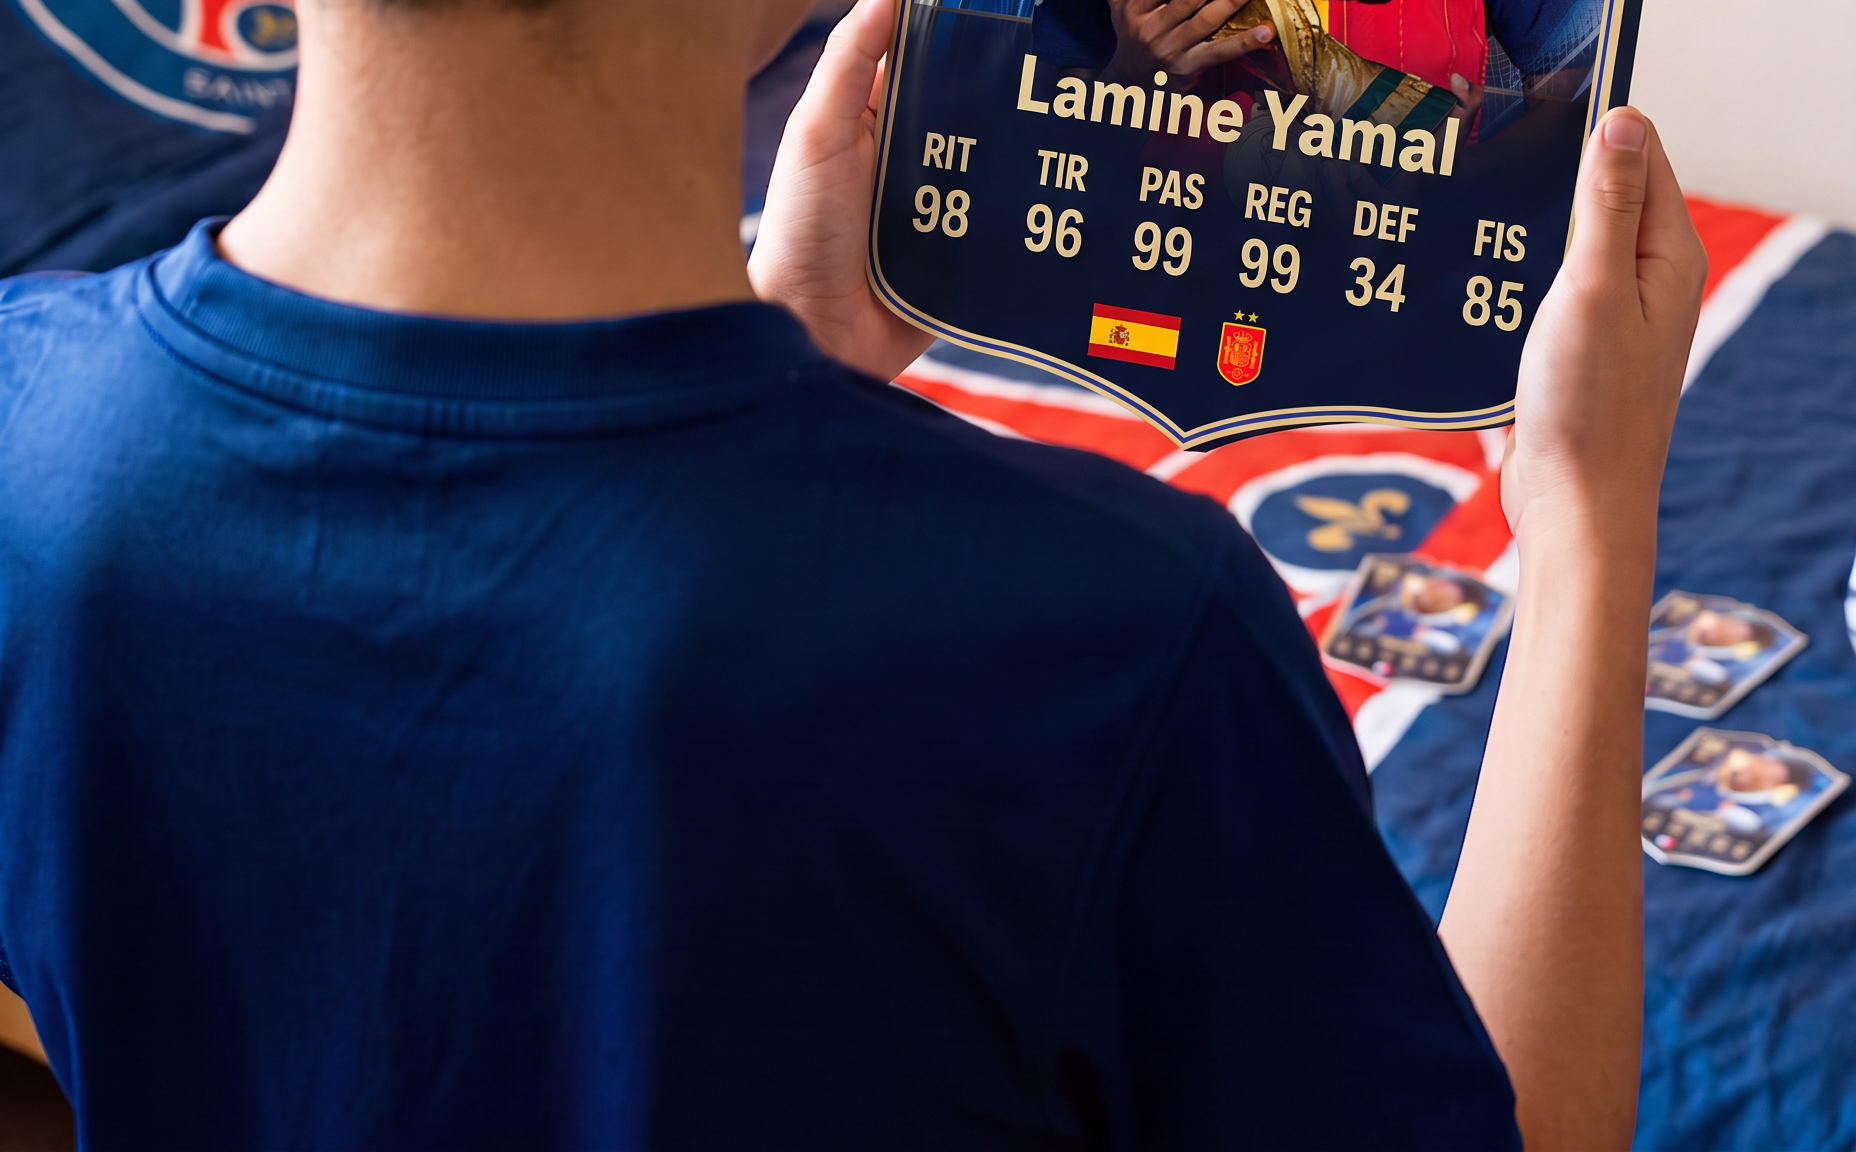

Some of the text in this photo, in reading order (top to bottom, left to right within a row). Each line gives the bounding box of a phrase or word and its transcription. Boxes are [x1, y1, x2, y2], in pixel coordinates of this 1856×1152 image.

[1017, 53, 1461, 177] Lamine Yamal
[912, 185, 1524, 332] 98 96 99 99 34 85
[922, 131, 1527, 262] RIT TIR PAS REG DEF FIS
